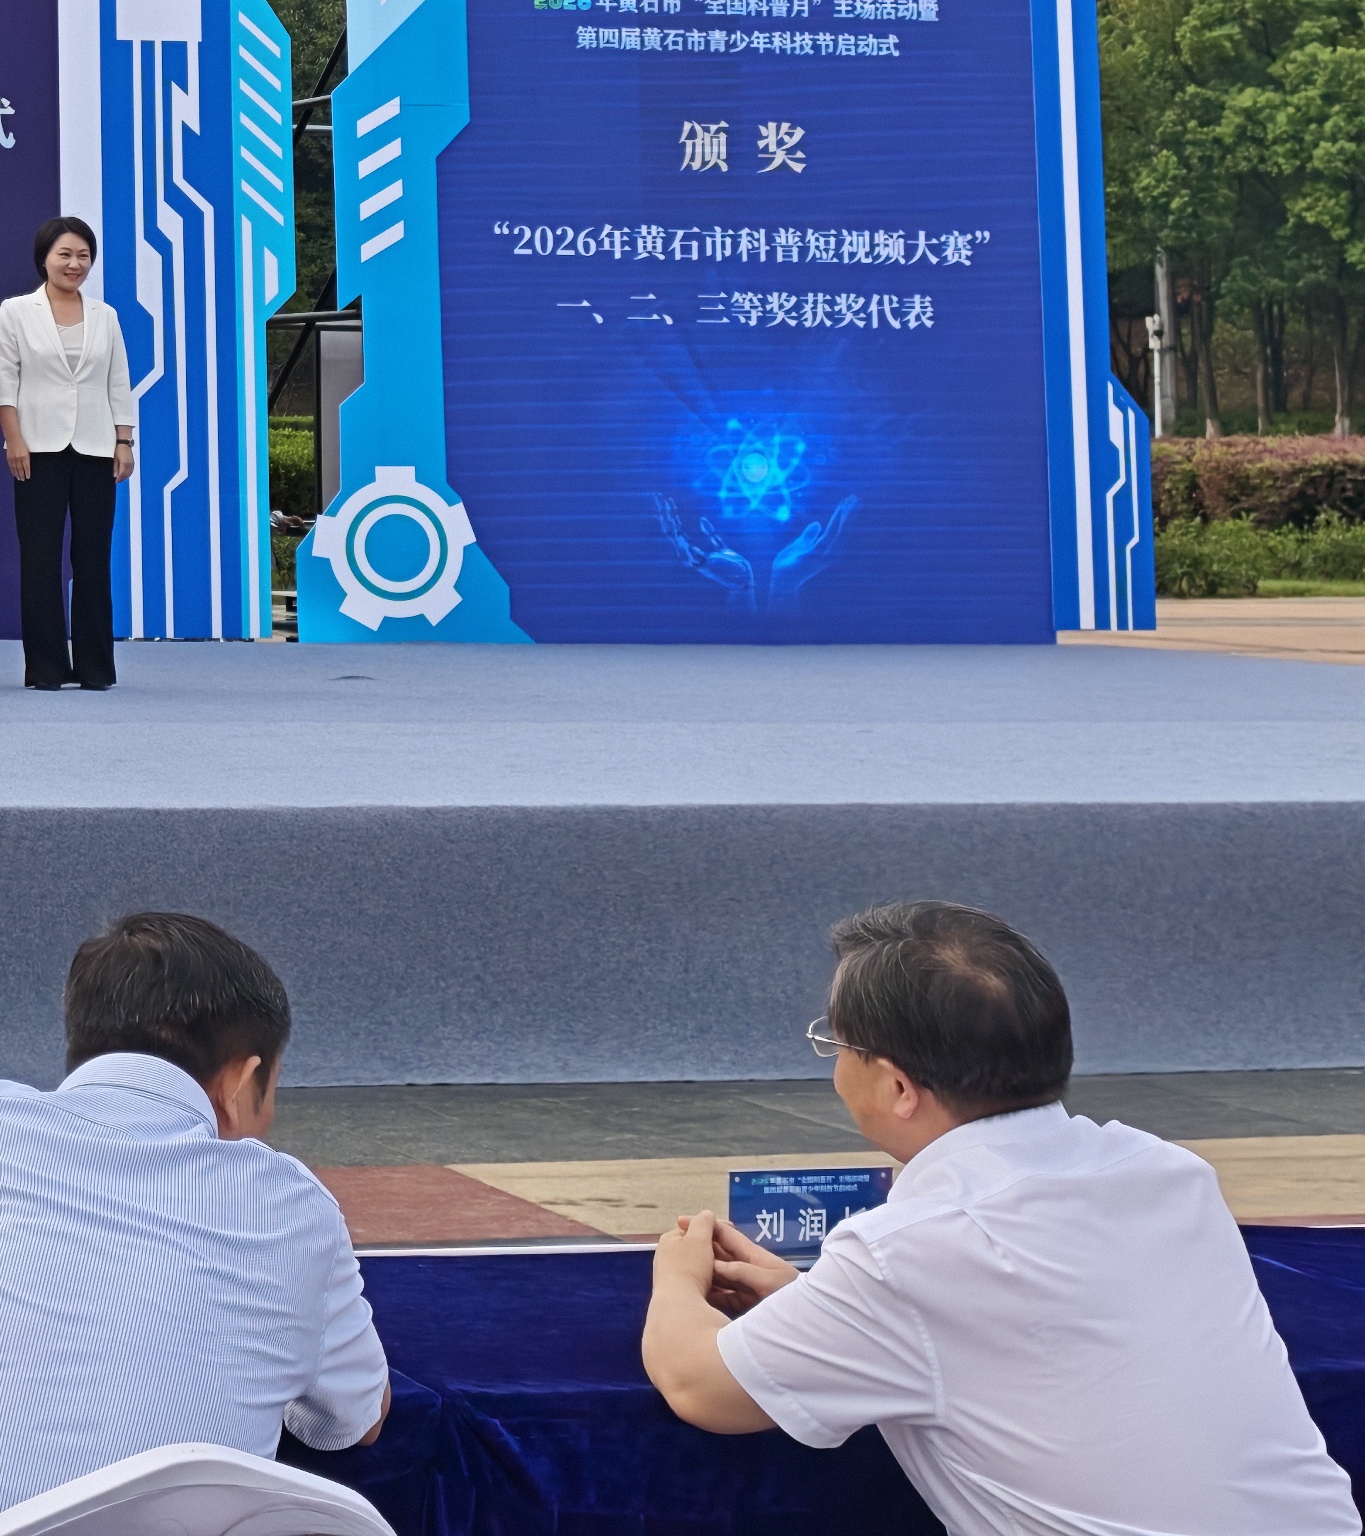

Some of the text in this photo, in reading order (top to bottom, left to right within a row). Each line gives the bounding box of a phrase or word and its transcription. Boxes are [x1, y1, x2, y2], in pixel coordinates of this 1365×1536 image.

[576, 24, 900, 57] 第四届黄石市青少年科技节启动式
[493, 221, 991, 266] “2026年黄石市科普短视频大赛”
[755, 1207, 867, 1242] 刘润
